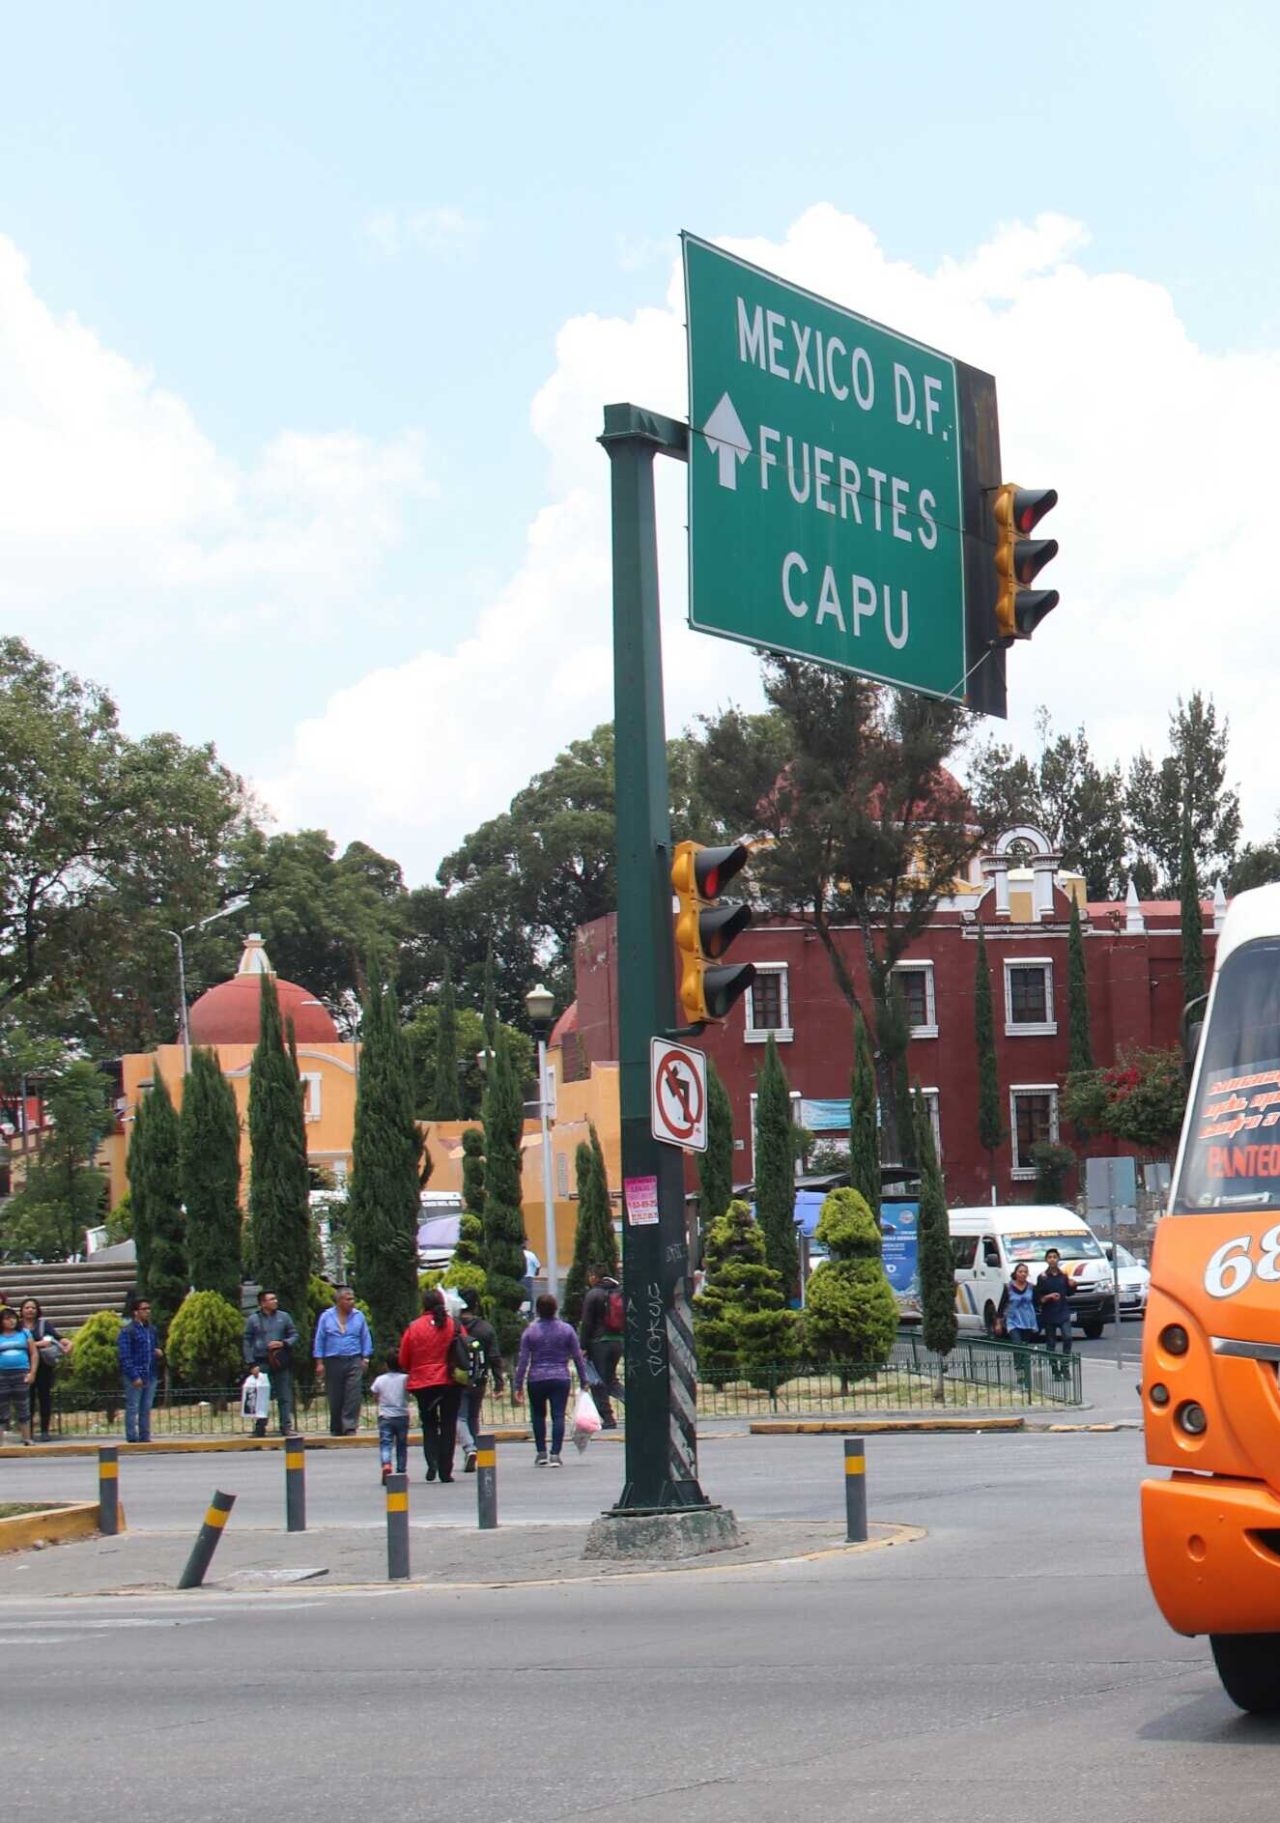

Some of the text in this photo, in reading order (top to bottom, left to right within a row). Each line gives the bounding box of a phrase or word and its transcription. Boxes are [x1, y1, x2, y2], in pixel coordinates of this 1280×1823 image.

[736, 296, 950, 442] MEXICO D.F.
[758, 424, 938, 551] FUERTES
[781, 551, 910, 650] CAPU
